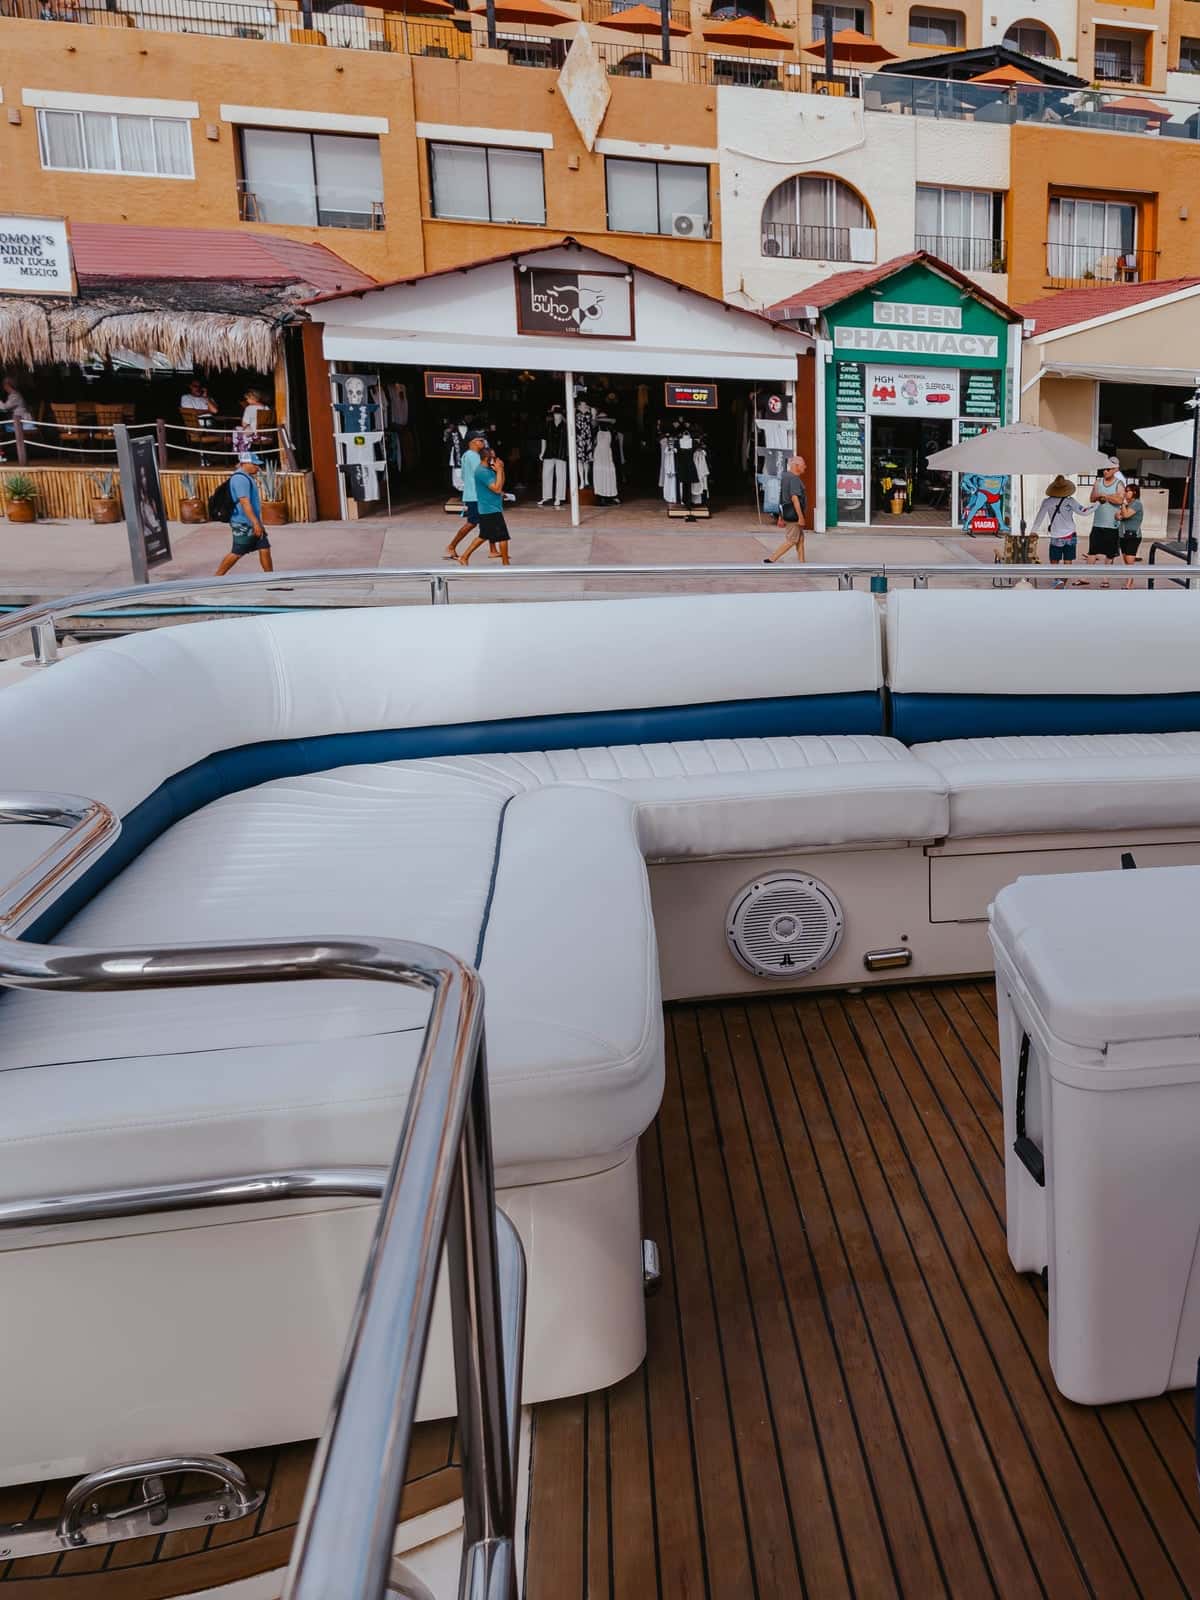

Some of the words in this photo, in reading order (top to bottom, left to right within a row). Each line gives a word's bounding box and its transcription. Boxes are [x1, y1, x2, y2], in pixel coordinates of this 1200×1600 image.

[3, 257, 24, 265] SAN
[20, 267, 58, 277] MEXICO
[876, 304, 960, 327] GREEN
[836, 329, 996, 355] PHARMACY
[874, 376, 894, 384] HGH
[435, 383, 451, 391] FREE
[974, 521, 996, 529] VIAGRA
